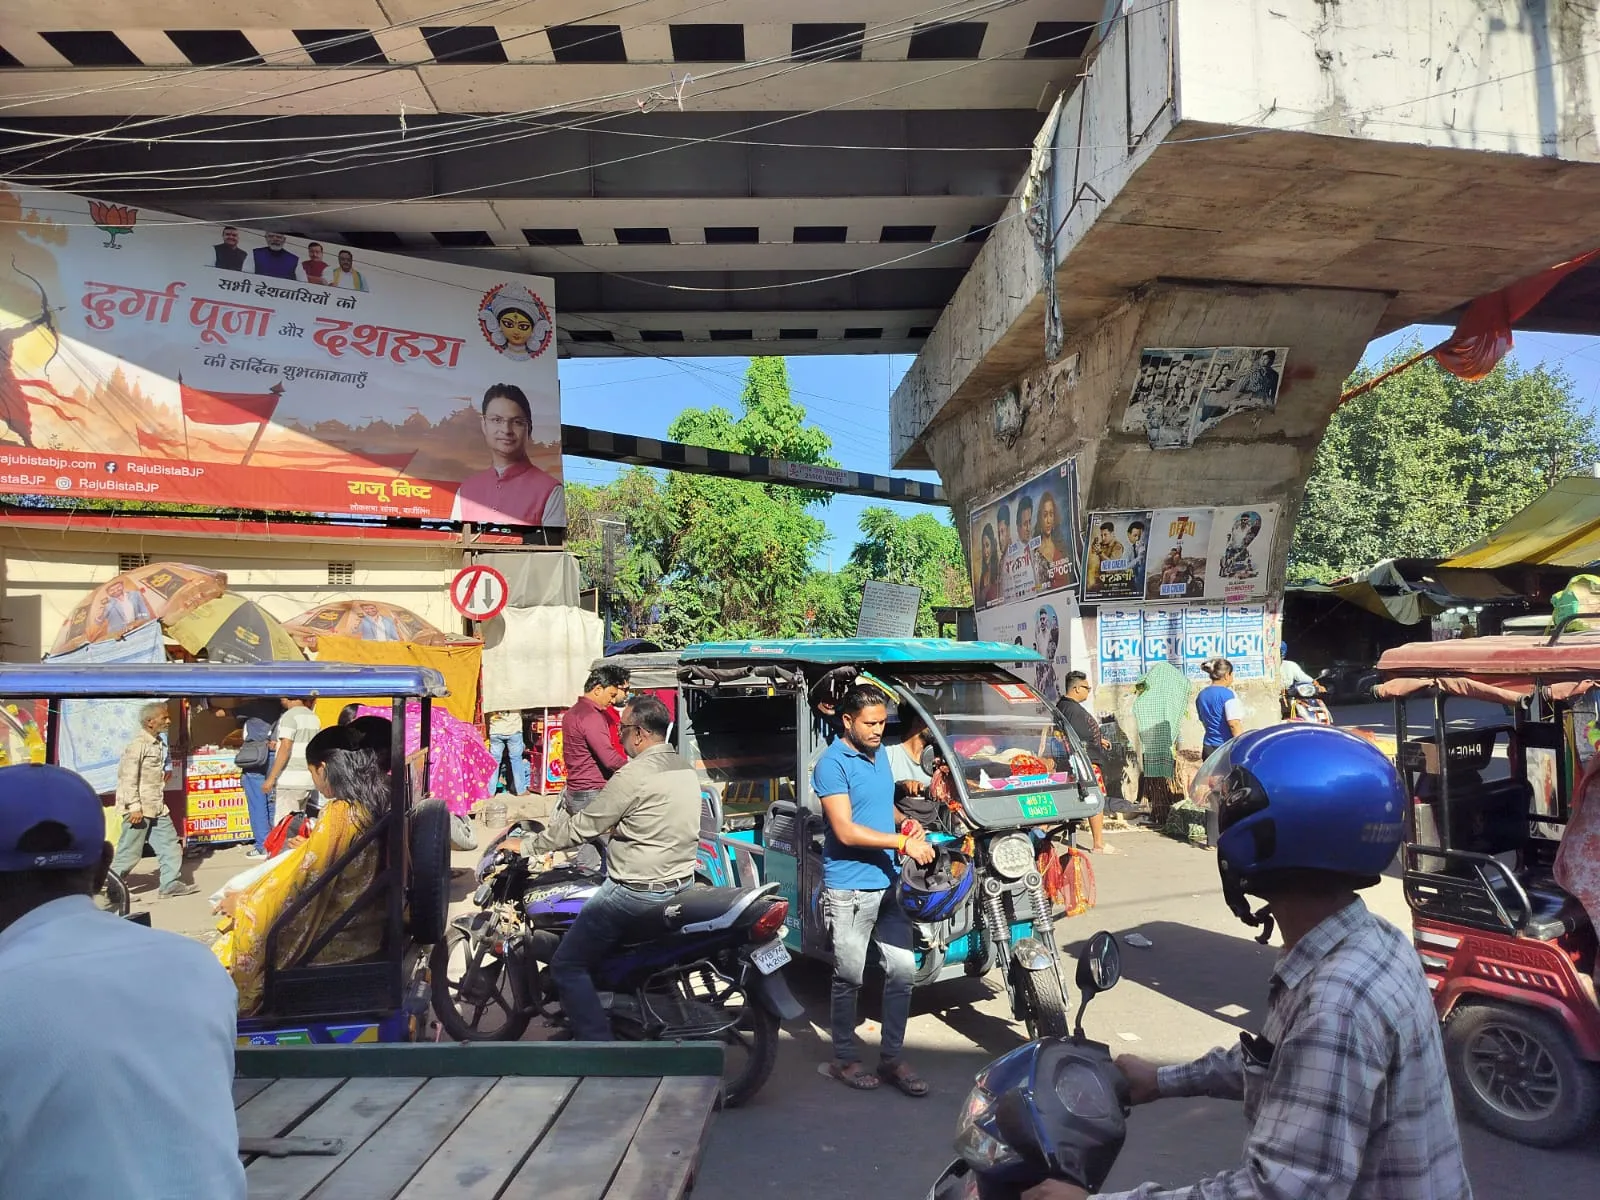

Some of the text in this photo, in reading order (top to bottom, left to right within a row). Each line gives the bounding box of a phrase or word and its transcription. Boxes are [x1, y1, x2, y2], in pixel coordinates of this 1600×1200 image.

[218, 278, 357, 310] सभी देशवासियों को
[81, 281, 467, 368] दुर्गा पूजा और दशहरा
[204, 353, 226, 369] की
[229, 357, 279, 375] हार्दिक
[127, 462, 205, 477] RajuBistaBJP
[79, 478, 159, 493] RajuBistaBJP
[347, 479, 433, 503] राजू बिष्ट
[1058, 562, 1072, 575] OCT
